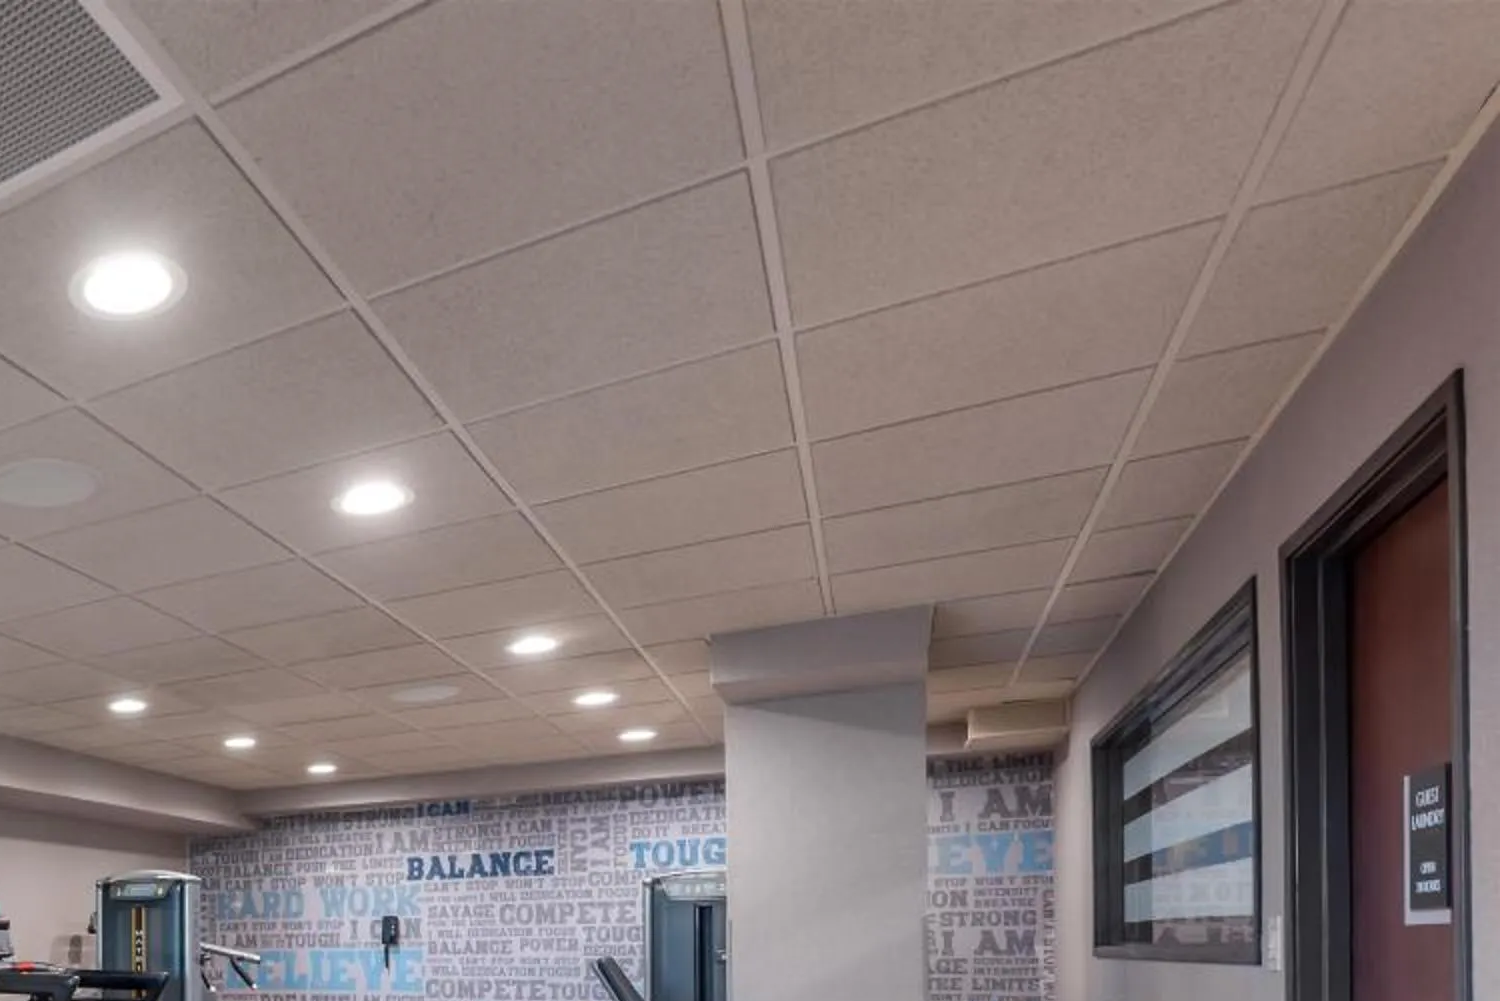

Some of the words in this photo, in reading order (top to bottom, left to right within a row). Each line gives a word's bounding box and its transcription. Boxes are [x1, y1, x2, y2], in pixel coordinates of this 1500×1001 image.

[991, 749, 1054, 771] LIMIT
[939, 791, 956, 822] I
[977, 784, 1053, 819] AM
[1415, 785, 1440, 808] GUEST
[628, 806, 726, 826] DEDICATI
[1013, 819, 1054, 830] FOCU
[1411, 807, 1445, 831] LAUNDRY
[390, 830, 430, 853] AM
[629, 836, 726, 869] TOUG
[928, 832, 1054, 874] EVE
[405, 850, 556, 882] BALANCE
[588, 868, 640, 888] COMP
[318, 883, 423, 918] WORK
[426, 903, 496, 919] SAVAGE
[498, 900, 637, 926] COMPETE
[938, 910, 1038, 928] STRONG
[284, 931, 342, 949] TOUGH
[349, 917, 359, 940] I
[369, 917, 423, 940] CN
[580, 925, 642, 943] TOUG
[426, 939, 513, 955] BALANCE
[519, 937, 579, 952] POWER
[583, 944, 642, 957] DEDICAT
[941, 930, 955, 956] I
[973, 929, 1038, 956] AM
[425, 978, 546, 1001] COMPETE
[548, 980, 607, 1001] TOUG
[971, 977, 1041, 992] LIMITS
